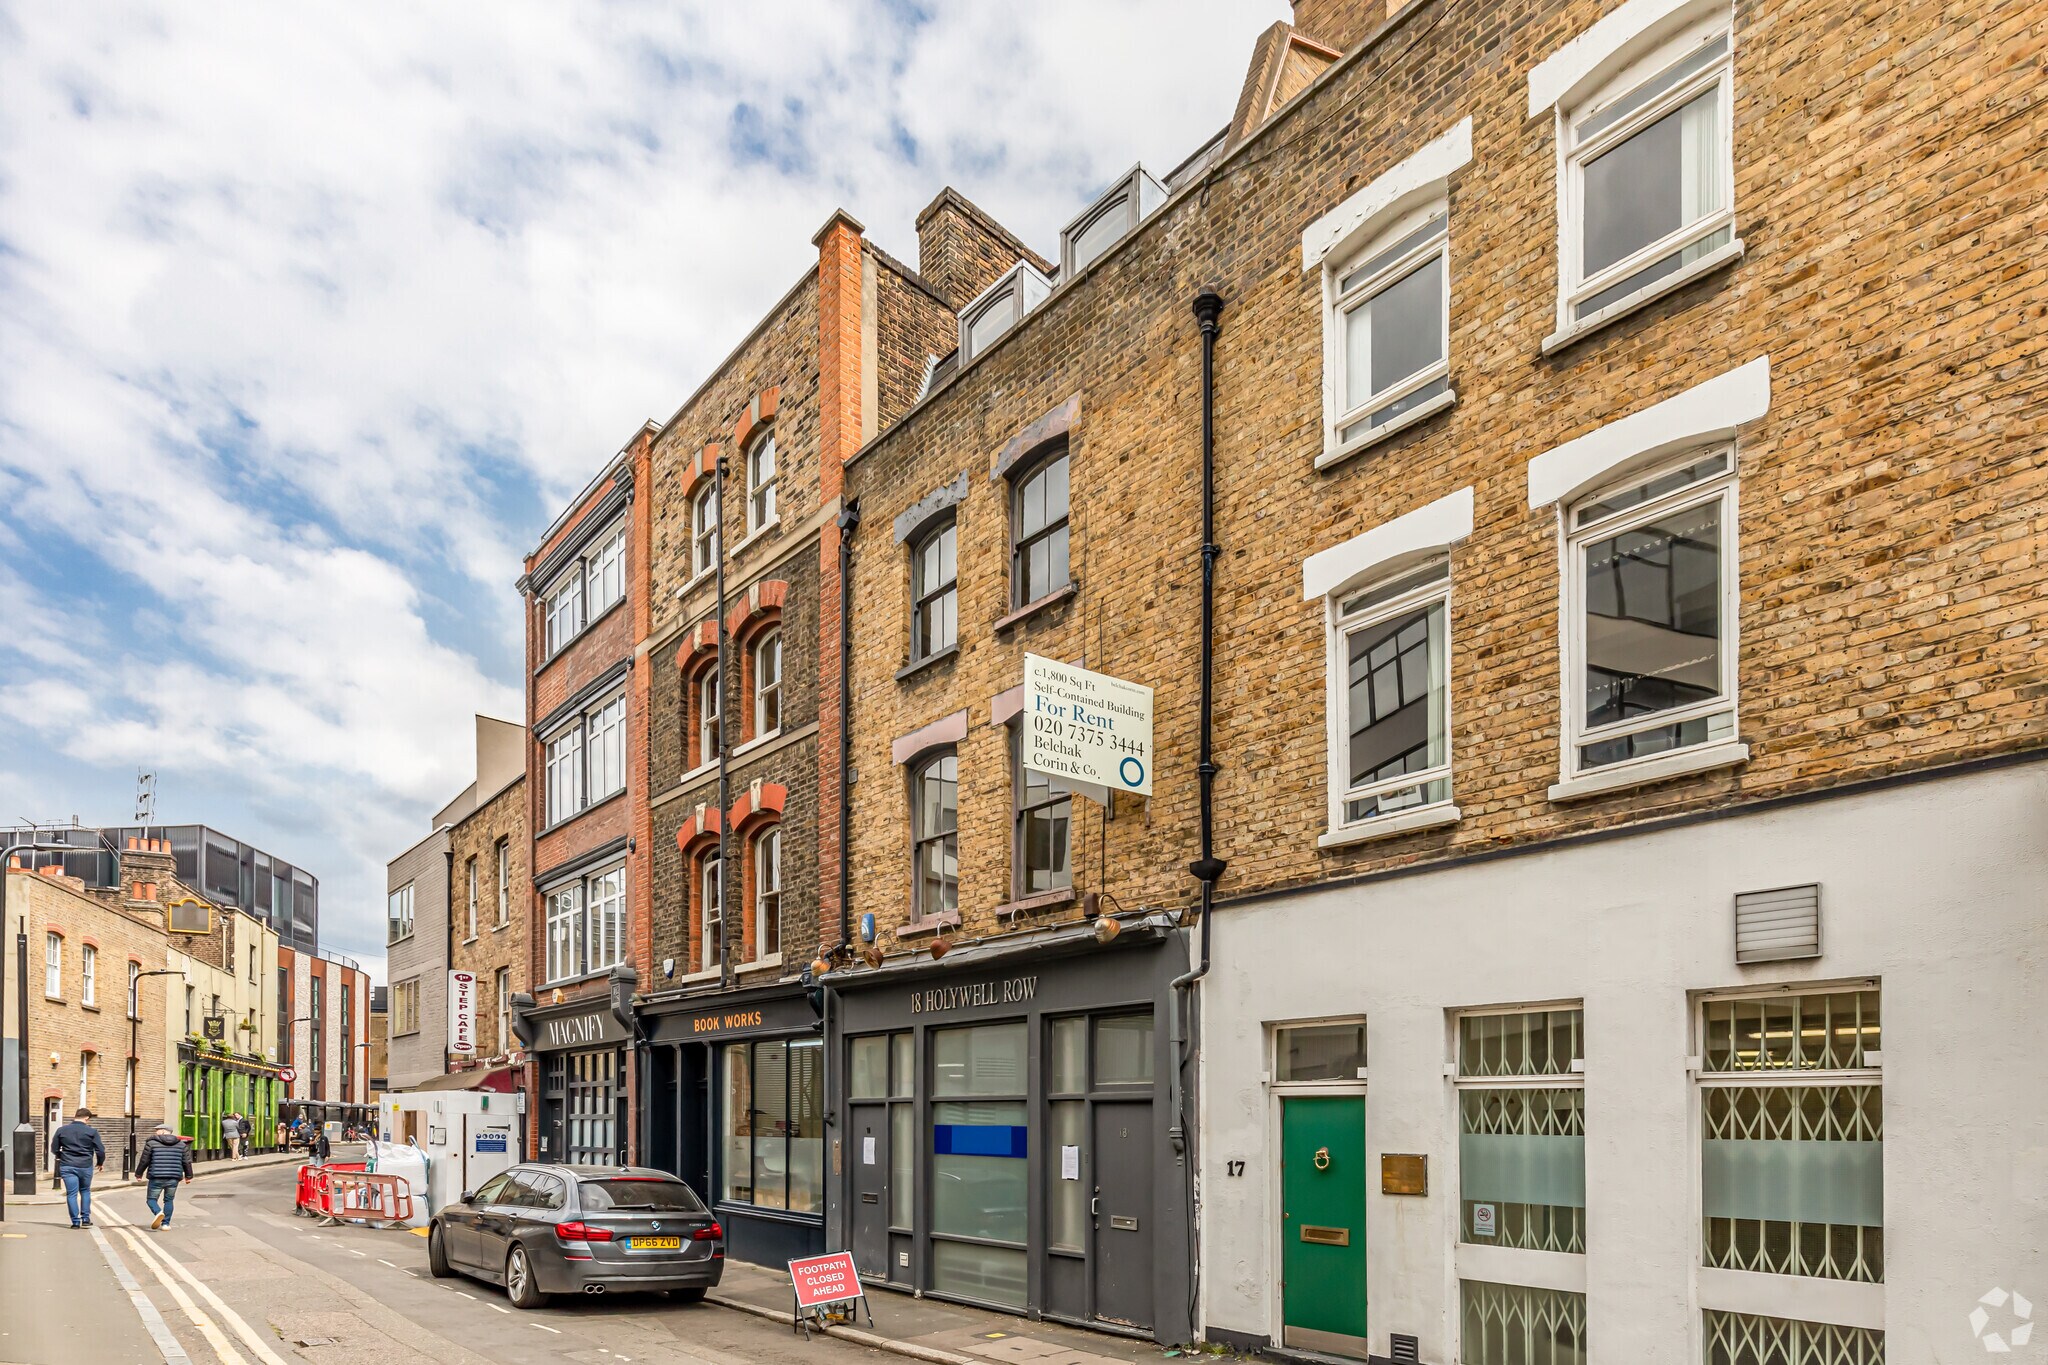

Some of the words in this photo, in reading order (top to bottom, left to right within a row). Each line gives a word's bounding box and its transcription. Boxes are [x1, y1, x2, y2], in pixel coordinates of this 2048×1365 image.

[1069, 676, 1082, 691] Sq
[1085, 681, 1096, 692] Ft
[1034, 681, 1104, 708] Self-Contained
[1107, 700, 1145, 721] Building
[1035, 694, 1067, 717] For
[1072, 704, 1115, 731] Rent
[1034, 715, 1063, 736] 020
[1067, 724, 1104, 746] 7375
[1109, 734, 1145, 757] 3444
[1034, 735, 1082, 758] Belchak
[1033, 753, 1068, 772] Corin
[1070, 763, 1080, 775] &
[458, 983, 469, 1010] STEP
[911, 992, 922, 1014] 18
[925, 983, 998, 1012] HOLYWELL
[1003, 976, 1038, 1003] ROW
[458, 1013, 468, 1041] CAFE
[549, 1014, 606, 1045] MAGNIFY
[694, 1019, 720, 1033] BOOK
[724, 1011, 762, 1029] WORKS
[1226, 1160, 1246, 1177] 17
[633, 1237, 658, 1247] DP66
[660, 1237, 679, 1247] ZVD
[798, 1260, 847, 1275] FOOTPATH
[807, 1272, 844, 1286] CLOSED
[813, 1284, 845, 1297] AHEAD
